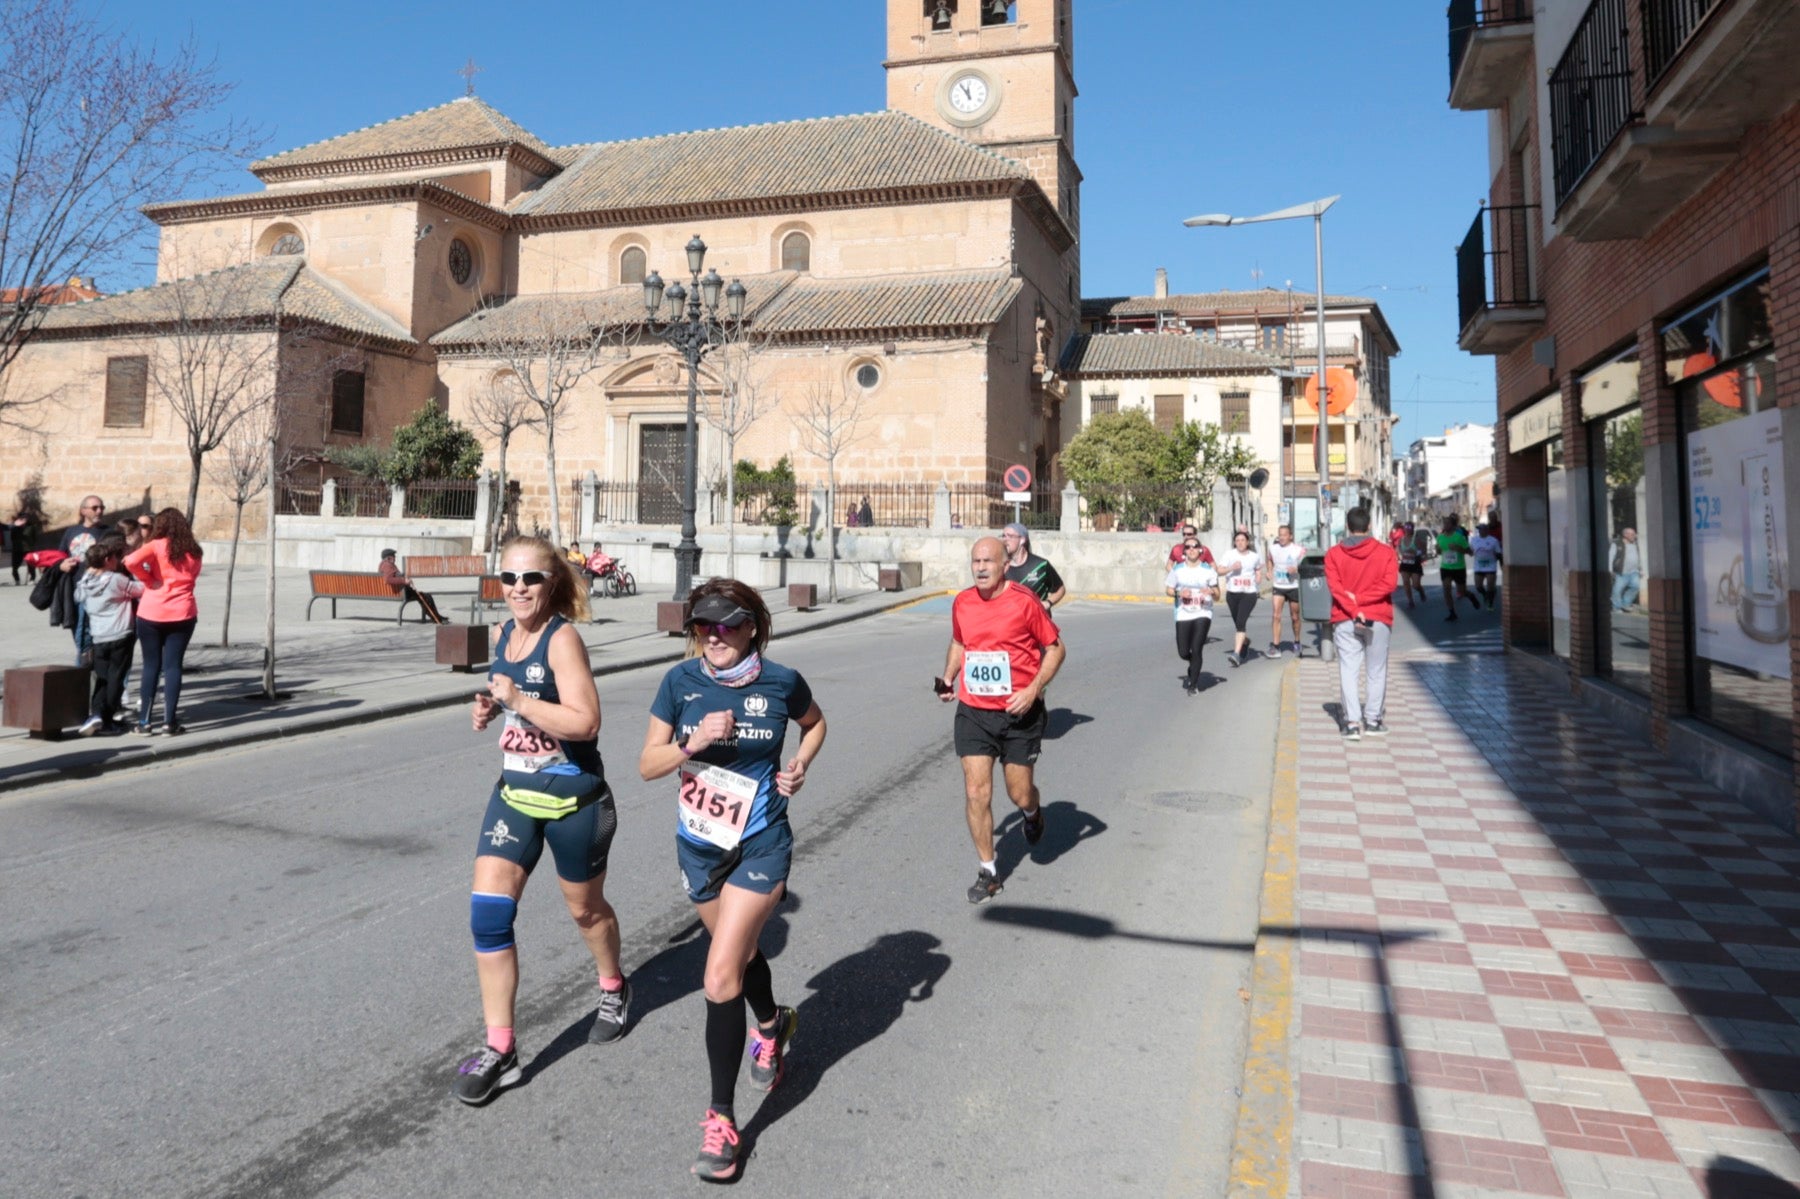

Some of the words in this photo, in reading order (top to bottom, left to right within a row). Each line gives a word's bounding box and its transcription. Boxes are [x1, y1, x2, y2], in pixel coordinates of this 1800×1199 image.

[971, 665, 1001, 682] 480
[503, 730, 556, 753] 2236
[683, 777, 744, 826] 2151
